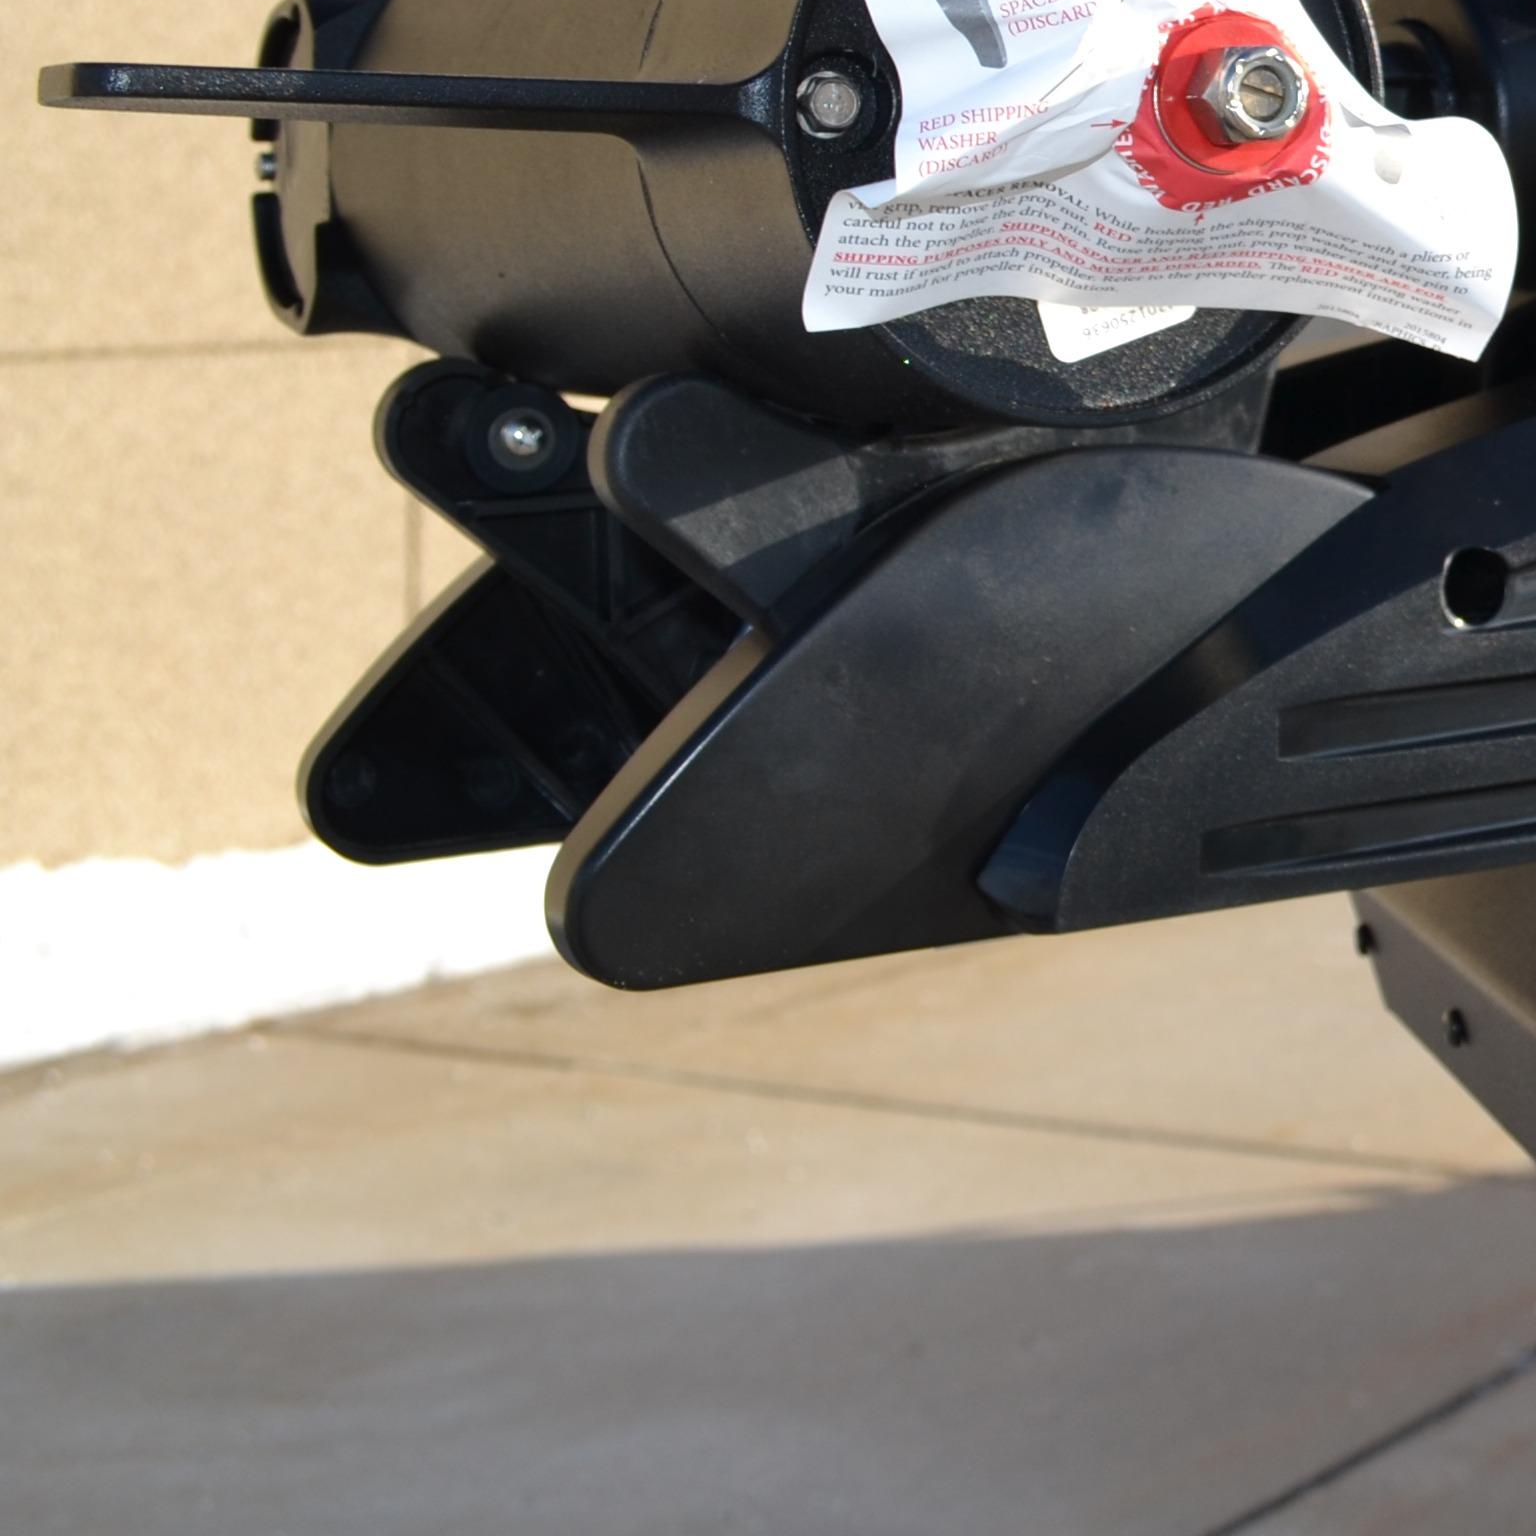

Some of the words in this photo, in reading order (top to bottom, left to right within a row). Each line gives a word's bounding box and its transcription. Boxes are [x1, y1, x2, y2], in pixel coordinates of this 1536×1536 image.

[917, 131, 997, 151] WASHER
[919, 113, 955, 133] RED
[961, 101, 1048, 124] SHIPPING
[919, 143, 1008, 177] (DISCARD)
[838, 234, 889, 246] attach
[895, 236, 921, 248] the
[925, 227, 995, 251] propeller.
[1000, 222, 1078, 249] SHIPPING
[1081, 246, 1141, 264] SPACER
[1147, 255, 1185, 264] AND
[1188, 252, 1227, 260] RED
[1230, 250, 1306, 263] SHIPPING
[1312, 256, 1376, 277] WASHER
[1378, 276, 1411, 289] ARE
[1415, 287, 1447, 301] FOR
[843, 216, 901, 230] careful
[906, 220, 933, 231] not
[939, 220, 955, 231] to
[959, 217, 988, 230] lose
[992, 208, 1016, 220] the
[1019, 206, 1060, 224] drive
[1062, 222, 1090, 241] pin.
[1096, 238, 1143, 254] Reuse
[1147, 246, 1172, 254] the
[1175, 245, 1213, 255] prop
[1251, 239, 1288, 250] prop
[1293, 244, 1346, 261] washer
[1349, 257, 1379, 269] and
[1381, 265, 1420, 283] drive
[1423, 279, 1449, 292] pin
[1453, 285, 1468, 295] to
[883, 202, 923, 215] grip,
[929, 203, 988, 214] remove
[992, 196, 1016, 208] the
[1018, 194, 1056, 210] prop
[1093, 221, 1132, 242] RED
[1136, 234, 1205, 246] shipping
[1210, 229, 1264, 241] washer,
[1268, 231, 1307, 242] prop
[1312, 237, 1366, 256] washer
[1368, 253, 1397, 266] and
[1400, 263, 1450, 279] spacer,
[1455, 265, 1492, 281] being
[1010, 181, 1089, 211] REMOVAL:
[1095, 207, 1141, 232] While
[1144, 226, 1206, 236] holding
[1210, 222, 1236, 231] the
[1238, 218, 1306, 230] shipping
[1309, 226, 1357, 245] spacer
[1362, 241, 1396, 255] with
[1399, 251, 1408, 259] a
[1411, 250, 1452, 263] pliers
[1455, 251, 1471, 261] or
[825, 282, 864, 296] your
[869, 279, 927, 297] manual
[931, 273, 949, 285] for
[954, 262, 1024, 282] propeller
[1028, 263, 1119, 293] installation.
[830, 267, 861, 279] will
[865, 270, 898, 280] rust
[904, 268, 919, 280] if
[919, 262, 954, 276] used
[956, 257, 971, 266] to
[974, 248, 1019, 262] attach
[1023, 252, 1095, 282] propeller.
[1103, 274, 1145, 283] Refer
[1167, 271, 1192, 280] the
[1195, 270, 1266, 281] propeller
[1270, 274, 1362, 295] replacement
[1367, 290, 1454, 324] instructions
[1458, 319, 1473, 330] in
[833, 251, 918, 265] SHIPPING
[923, 238, 999, 265] PURPOSES
[1004, 236, 1048, 249] ONLY
[1051, 247, 1086, 266] AND
[1089, 264, 1137, 274] MUST
[1140, 265, 1161, 273] BE
[1165, 262, 1261, 272] DISCARDED.
[1267, 262, 1296, 272] The
[1300, 265, 1338, 278] RED
[1342, 275, 1406, 299] shipping
[1410, 294, 1462, 315] washer
[1404, 322, 1447, 345] 2015804
